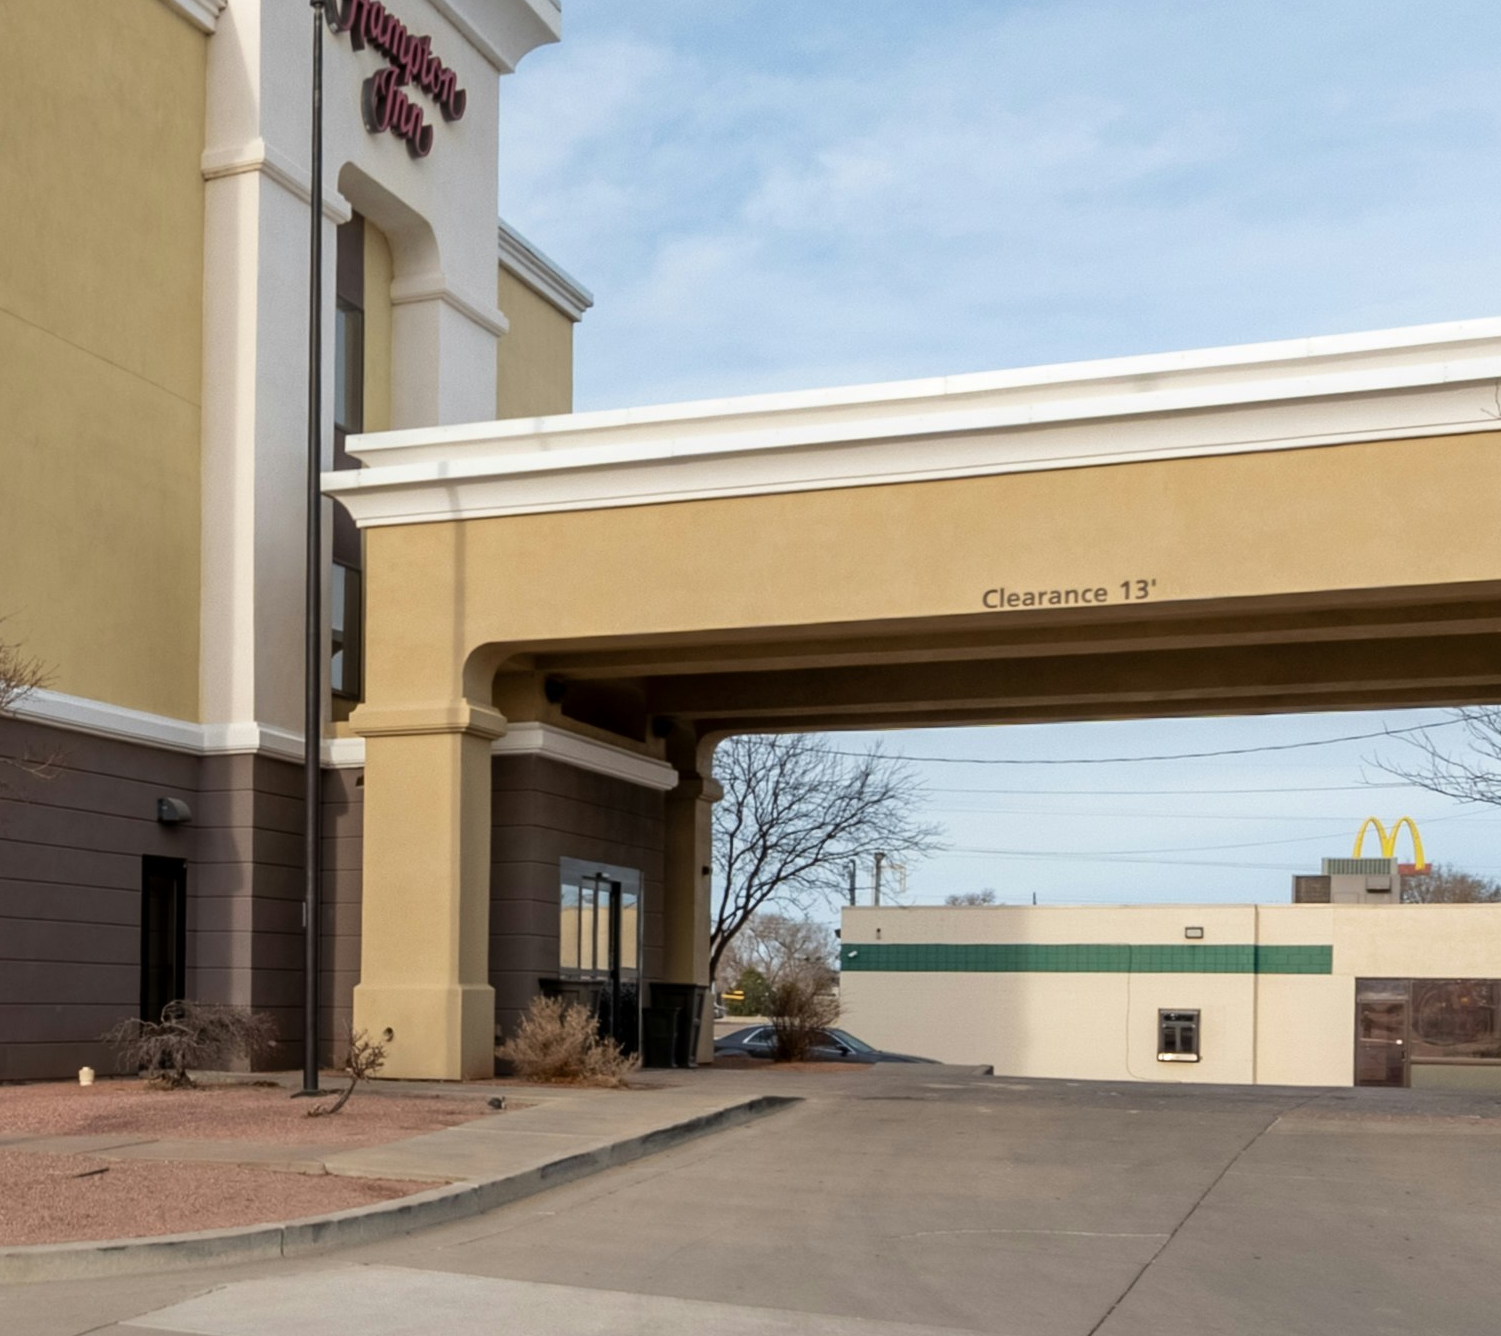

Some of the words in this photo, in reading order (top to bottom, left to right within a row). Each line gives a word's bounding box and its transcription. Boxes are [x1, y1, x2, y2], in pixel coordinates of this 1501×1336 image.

[361, 65, 433, 160] Inn
[981, 587, 1108, 609] Clearance
[1119, 578, 1157, 600] 13'
